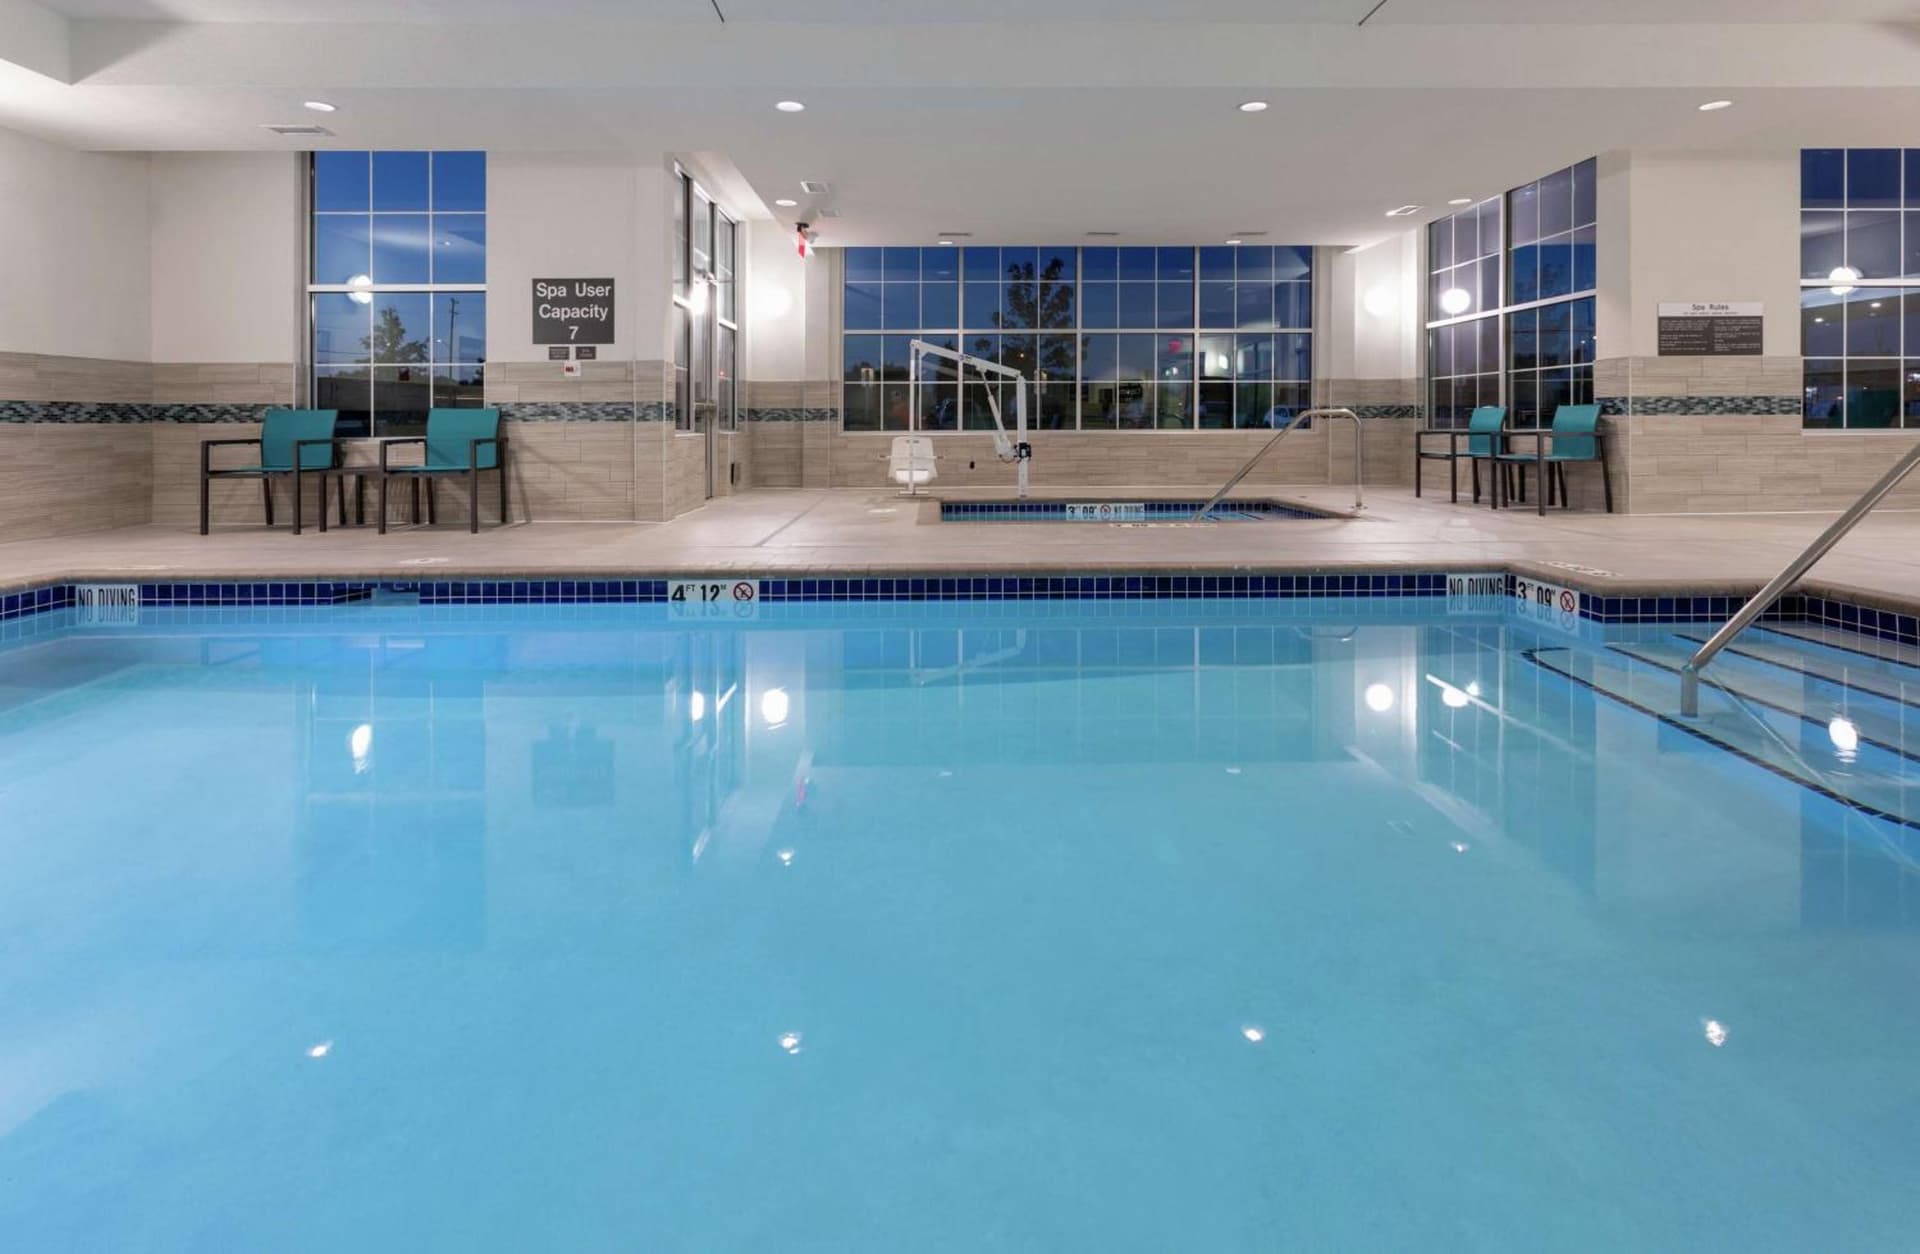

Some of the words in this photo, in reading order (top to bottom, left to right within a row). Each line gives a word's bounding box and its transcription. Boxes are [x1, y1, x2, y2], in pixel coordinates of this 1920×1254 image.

[536, 282, 567, 300] Spa
[575, 282, 612, 297] User
[539, 304, 608, 321] Capacity
[569, 326, 579, 340] 7
[1449, 577, 1463, 596] NO
[1468, 577, 1503, 596] DIVING
[79, 588, 93, 607] NO
[98, 588, 136, 607] DIVING
